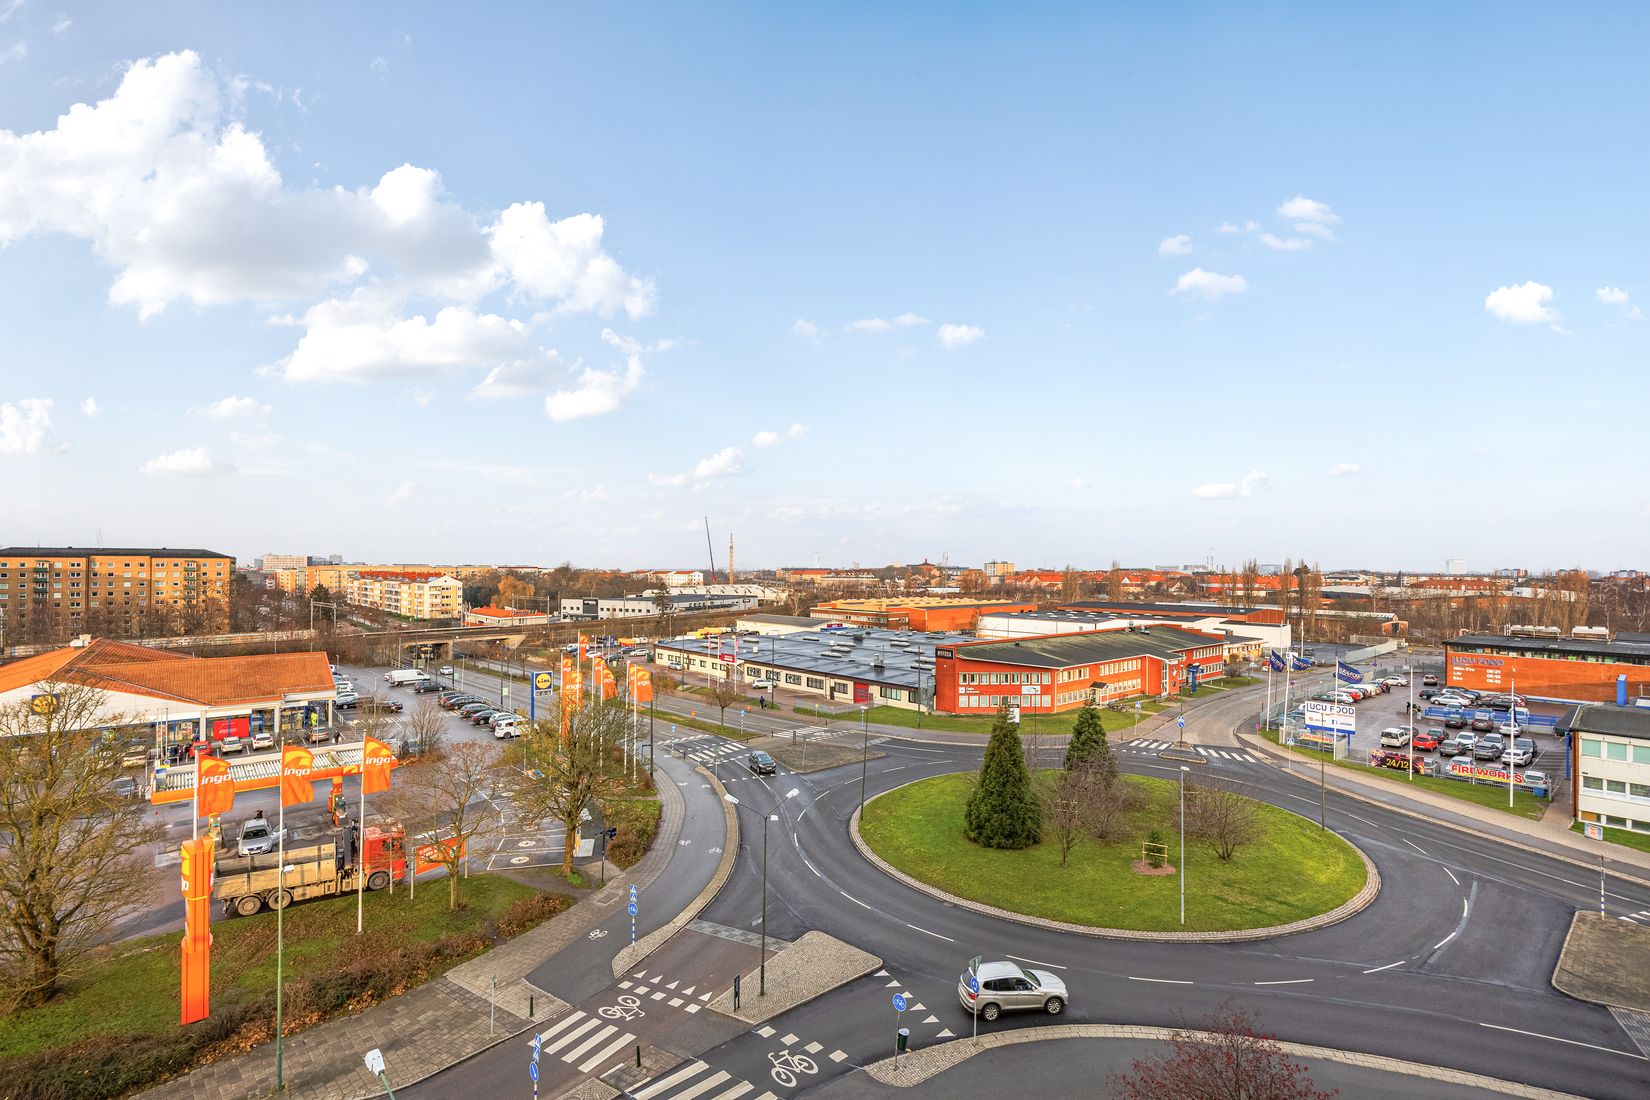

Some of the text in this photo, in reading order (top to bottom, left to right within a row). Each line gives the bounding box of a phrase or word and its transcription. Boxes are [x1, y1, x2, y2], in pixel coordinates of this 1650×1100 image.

[1306, 702, 1327, 713] LUCU
[365, 757, 391, 765] ingo
[284, 767, 310, 776] ingo
[202, 774, 231, 785] ingo
